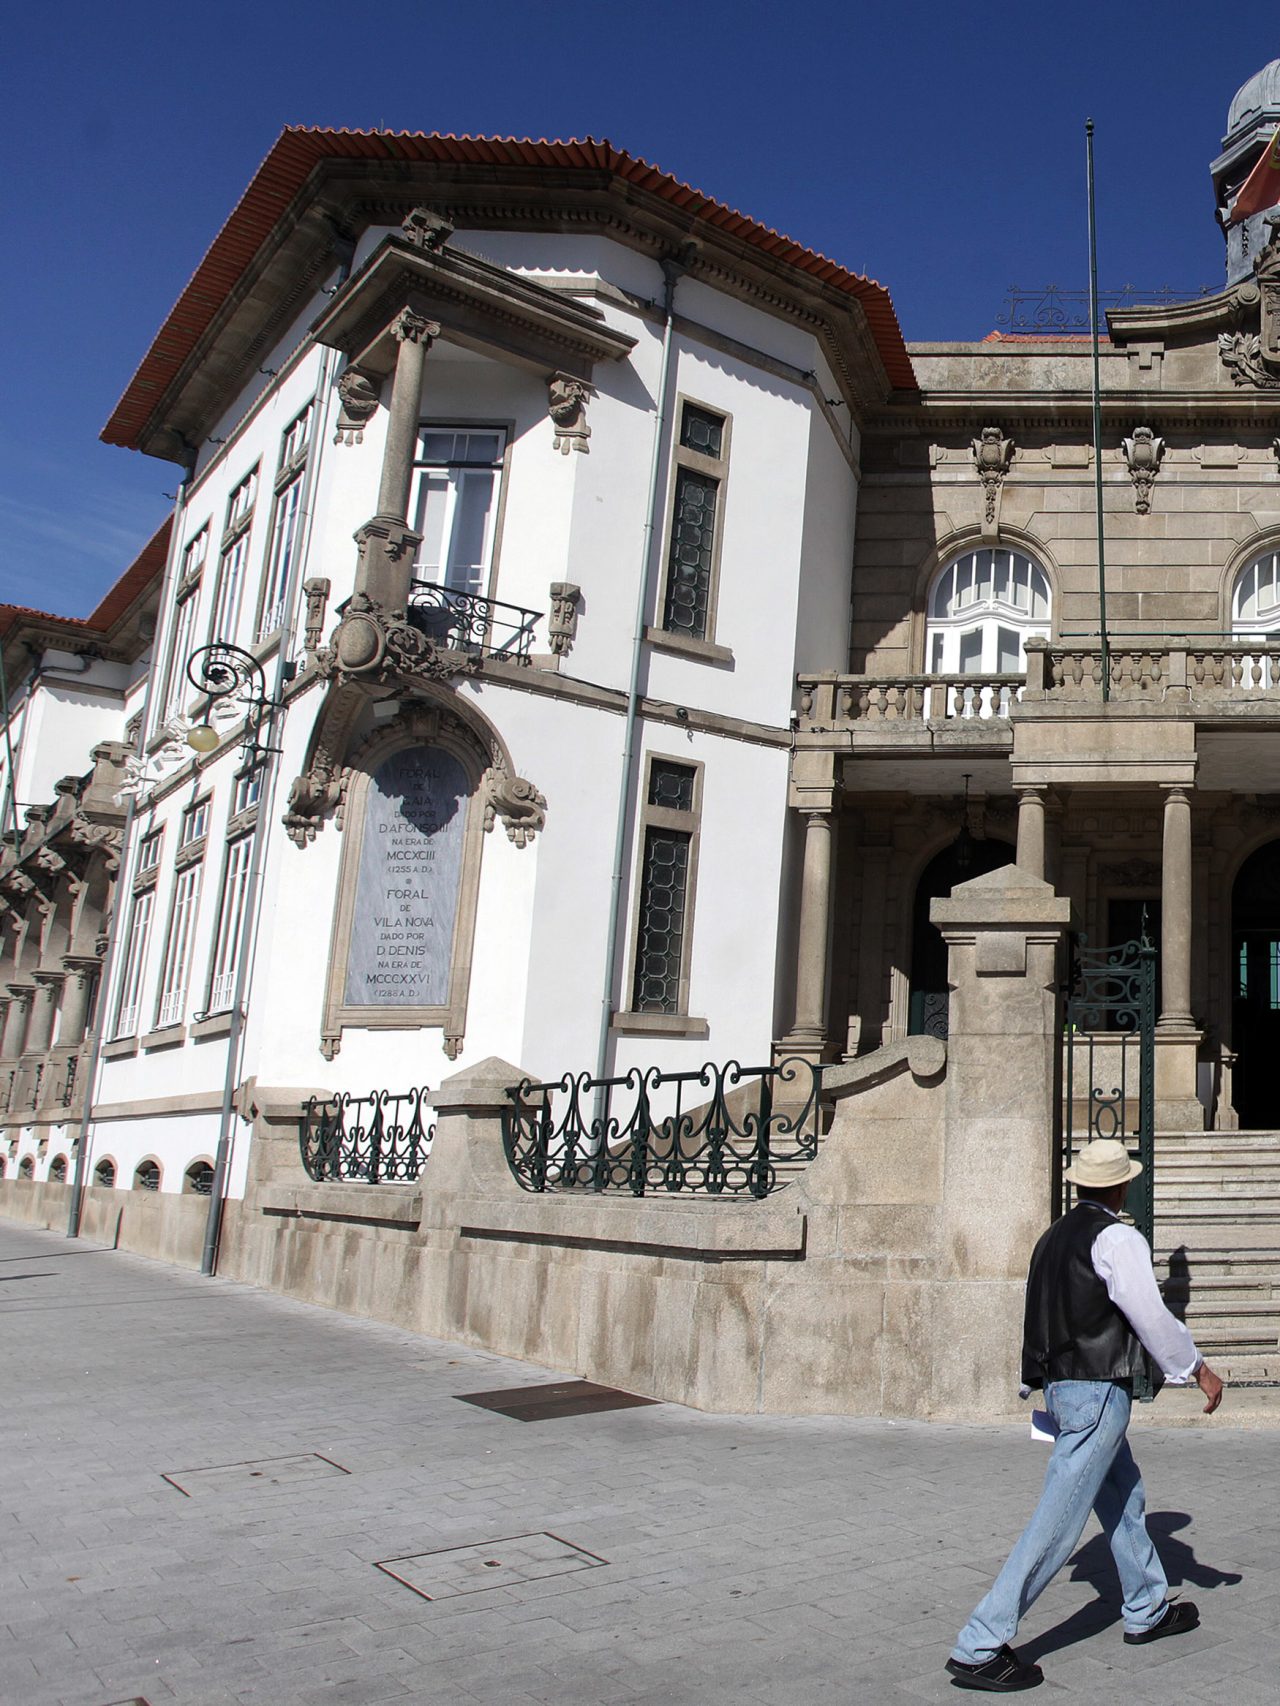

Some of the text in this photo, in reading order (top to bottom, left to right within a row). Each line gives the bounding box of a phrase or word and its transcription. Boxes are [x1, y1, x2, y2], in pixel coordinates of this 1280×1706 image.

[400, 769, 440, 778] FORAL
[392, 838, 434, 846] NA ERA DE
[387, 851, 435, 860] MCCXCIII
[387, 889, 429, 899] FORAL
[374, 918, 434, 927] VILA NOVA
[388, 946, 426, 955] DENIS
[366, 974, 430, 984] MCCCXXVI
